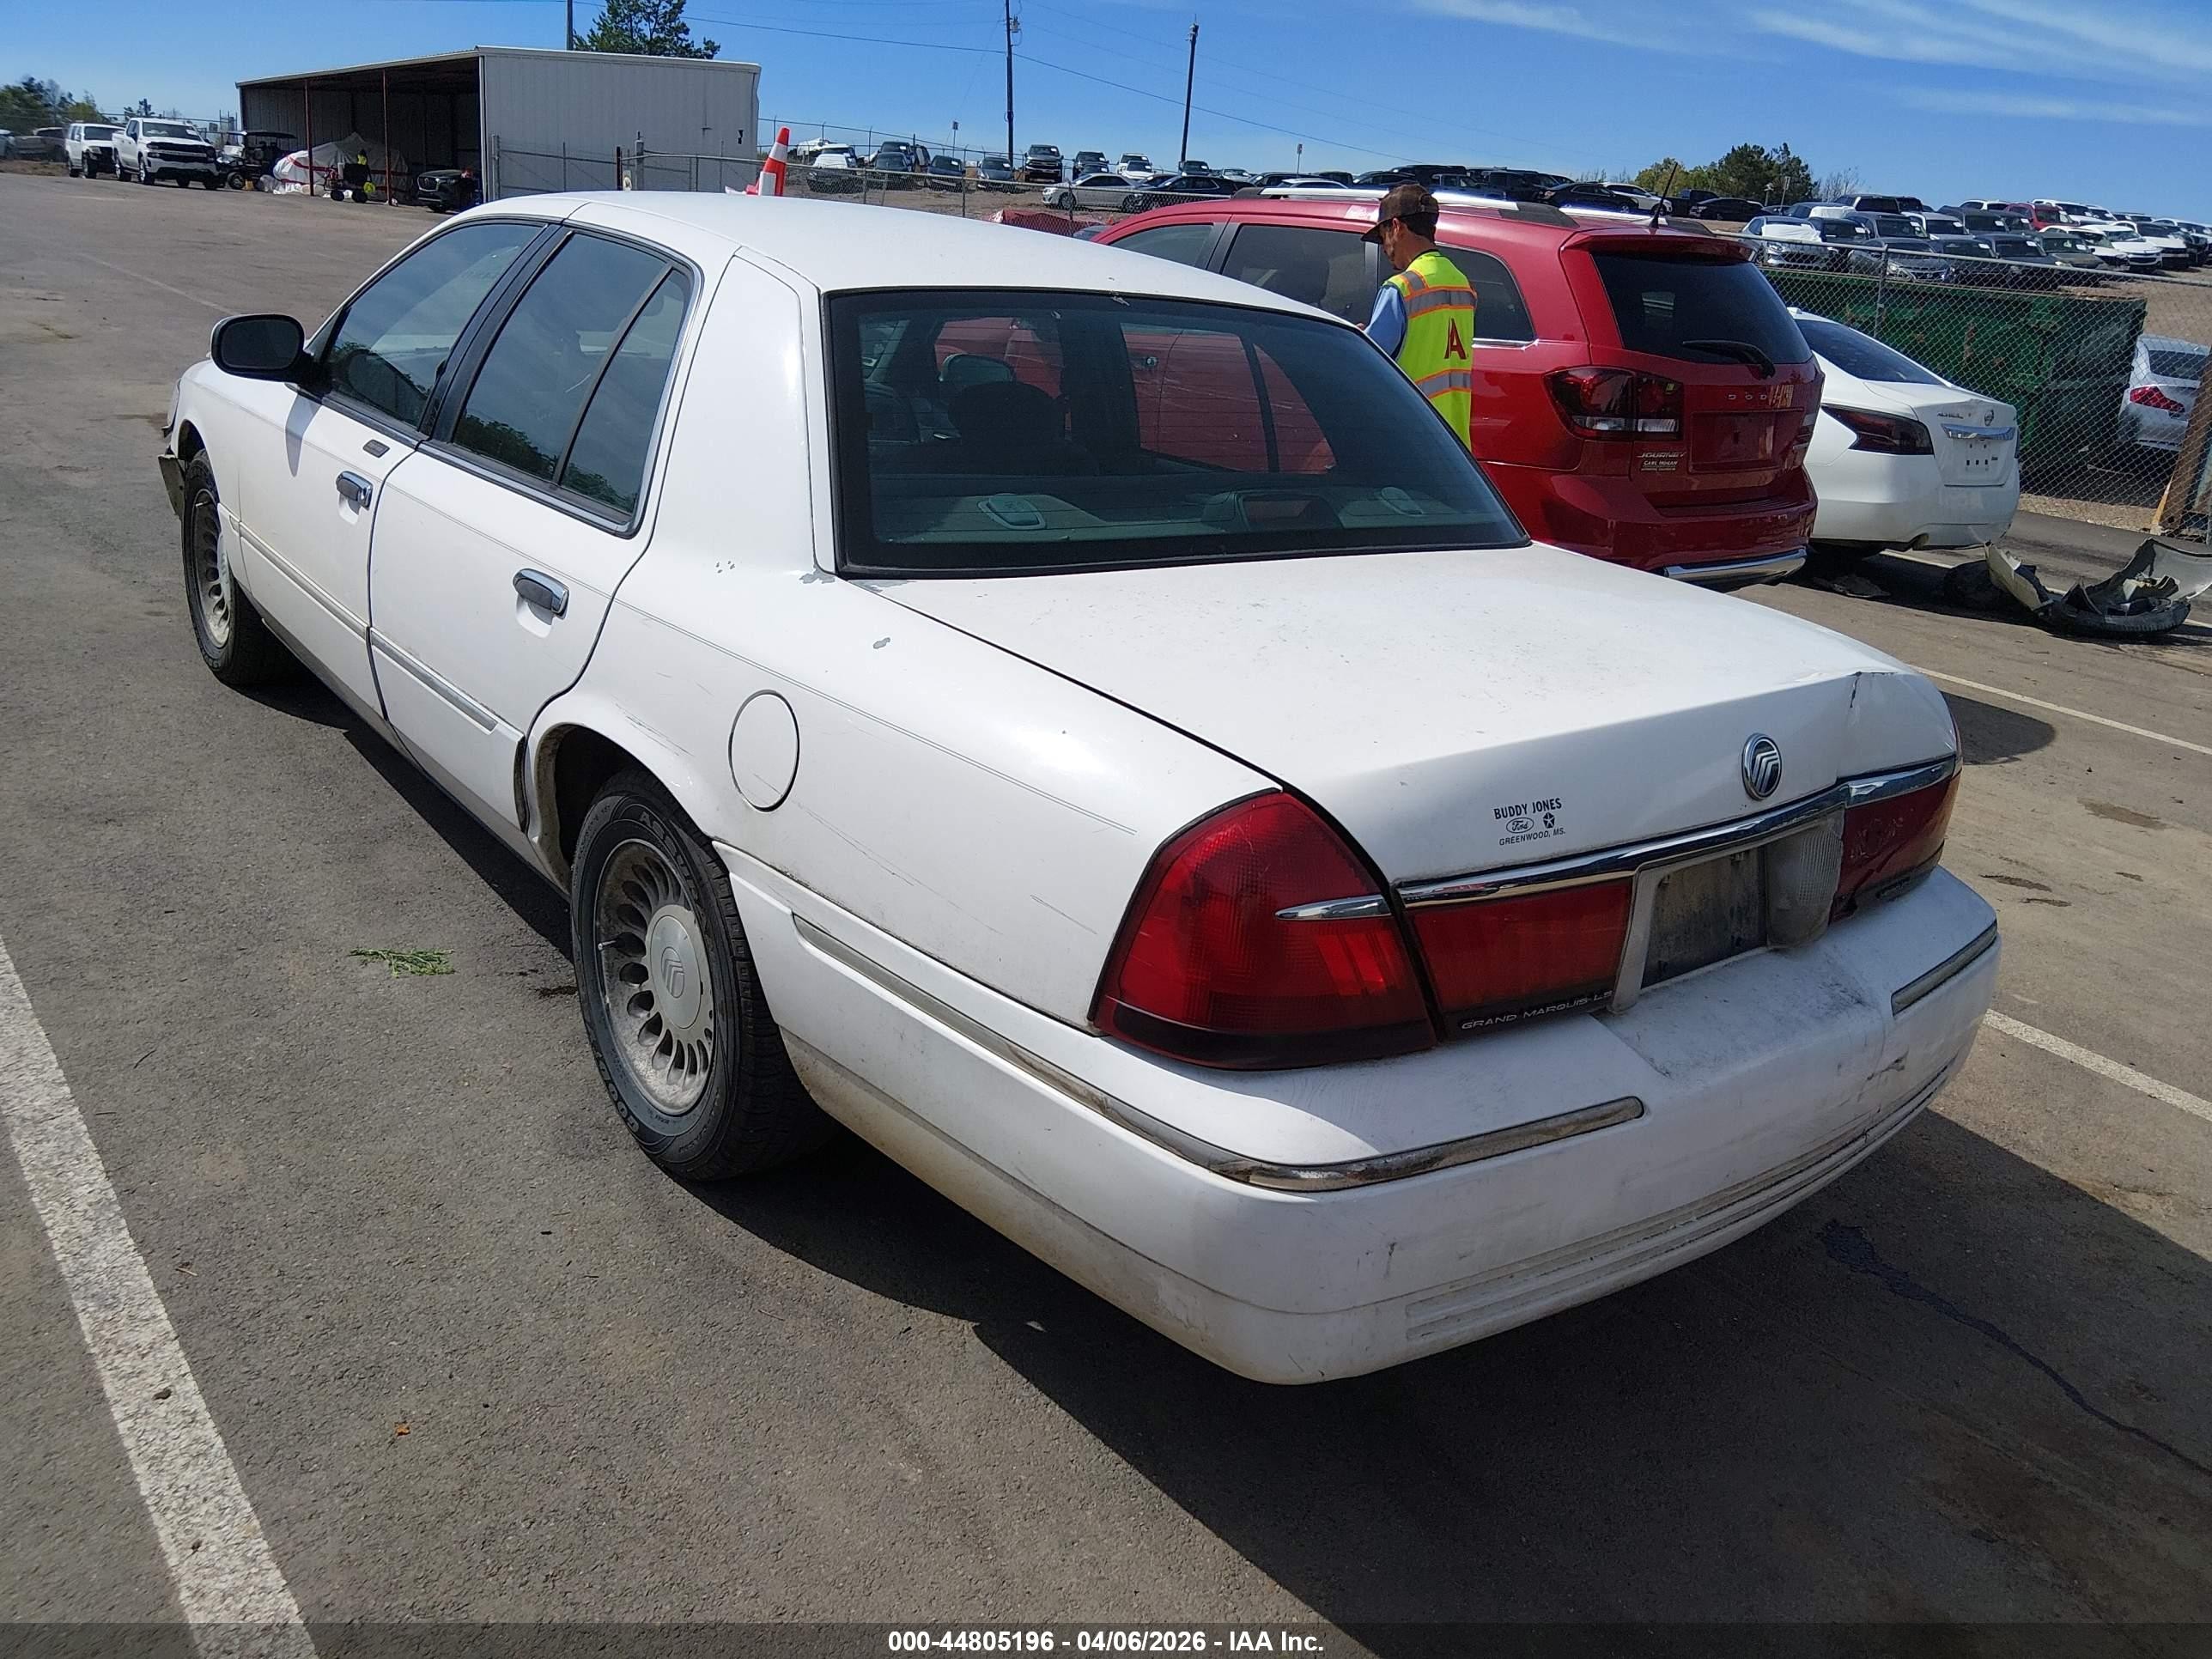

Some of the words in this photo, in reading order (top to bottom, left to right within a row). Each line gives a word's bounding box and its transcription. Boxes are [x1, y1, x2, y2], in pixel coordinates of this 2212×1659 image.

[1443, 317, 1468, 360] A
[1494, 803, 1528, 820] BUDDY
[1532, 798, 1562, 814] JONES
[1499, 830, 1551, 846] GREENWOOD,
[1553, 827, 1566, 836] MS.
[1511, 819, 1529, 832] Ford
[1462, 1014, 1517, 1030] GRAND
[1522, 997, 1589, 1019] MARQUIS
